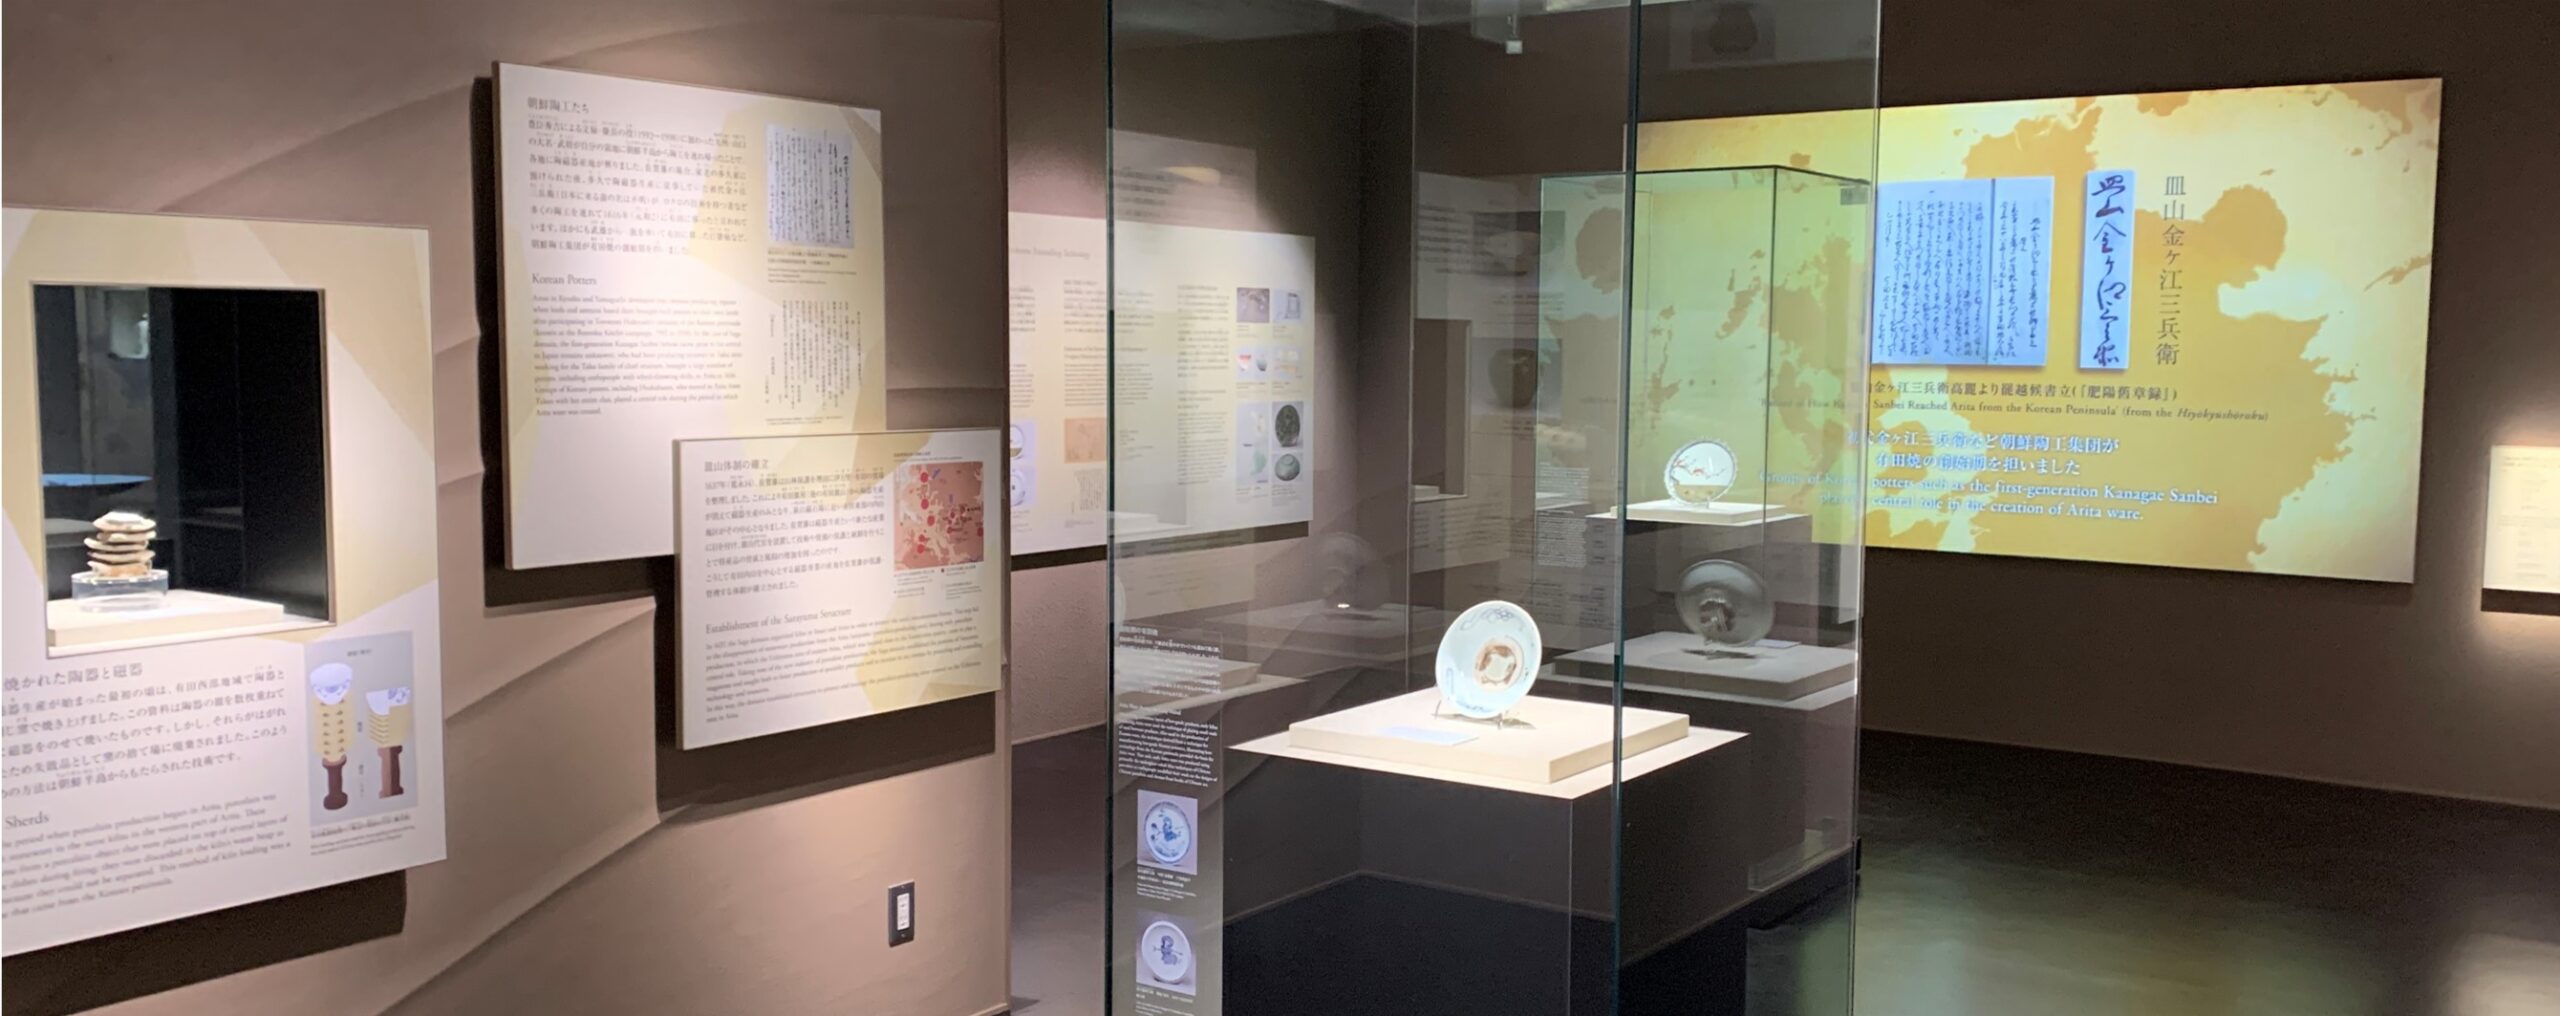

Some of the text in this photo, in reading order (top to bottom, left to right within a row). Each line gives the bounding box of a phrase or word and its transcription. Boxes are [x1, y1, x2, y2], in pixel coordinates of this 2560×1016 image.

[532, 273, 597, 284] Korean Potters
[2156, 175, 2187, 366] 皿山金ヶ江三兵衛
[1873, 400, 1904, 410] Sanbei
[1908, 401, 1948, 411] Reached
[1951, 402, 1975, 412] Arita
[1979, 402, 2002, 413] from
[2006, 403, 2022, 413] the
[2025, 403, 2062, 414] Korean
[2123, 406, 2152, 418] (from
[2156, 406, 2173, 418] the
[1872, 478, 1912, 490] potters
[1920, 478, 1946, 490] such
[1951, 482, 1964, 491] as
[1970, 479, 1990, 493] the
[1995, 480, 2098, 498] first-generation
[2104, 485, 2164, 504] Kanagae
[2169, 488, 2218, 504] Sanbei
[1873, 496, 2144, 520] central role in the creation of Arita ware.
[705, 617, 758, 634] Establishment
[760, 615, 769, 626] of
[770, 614, 781, 625] the
[5, 808, 49, 830] Sherds
